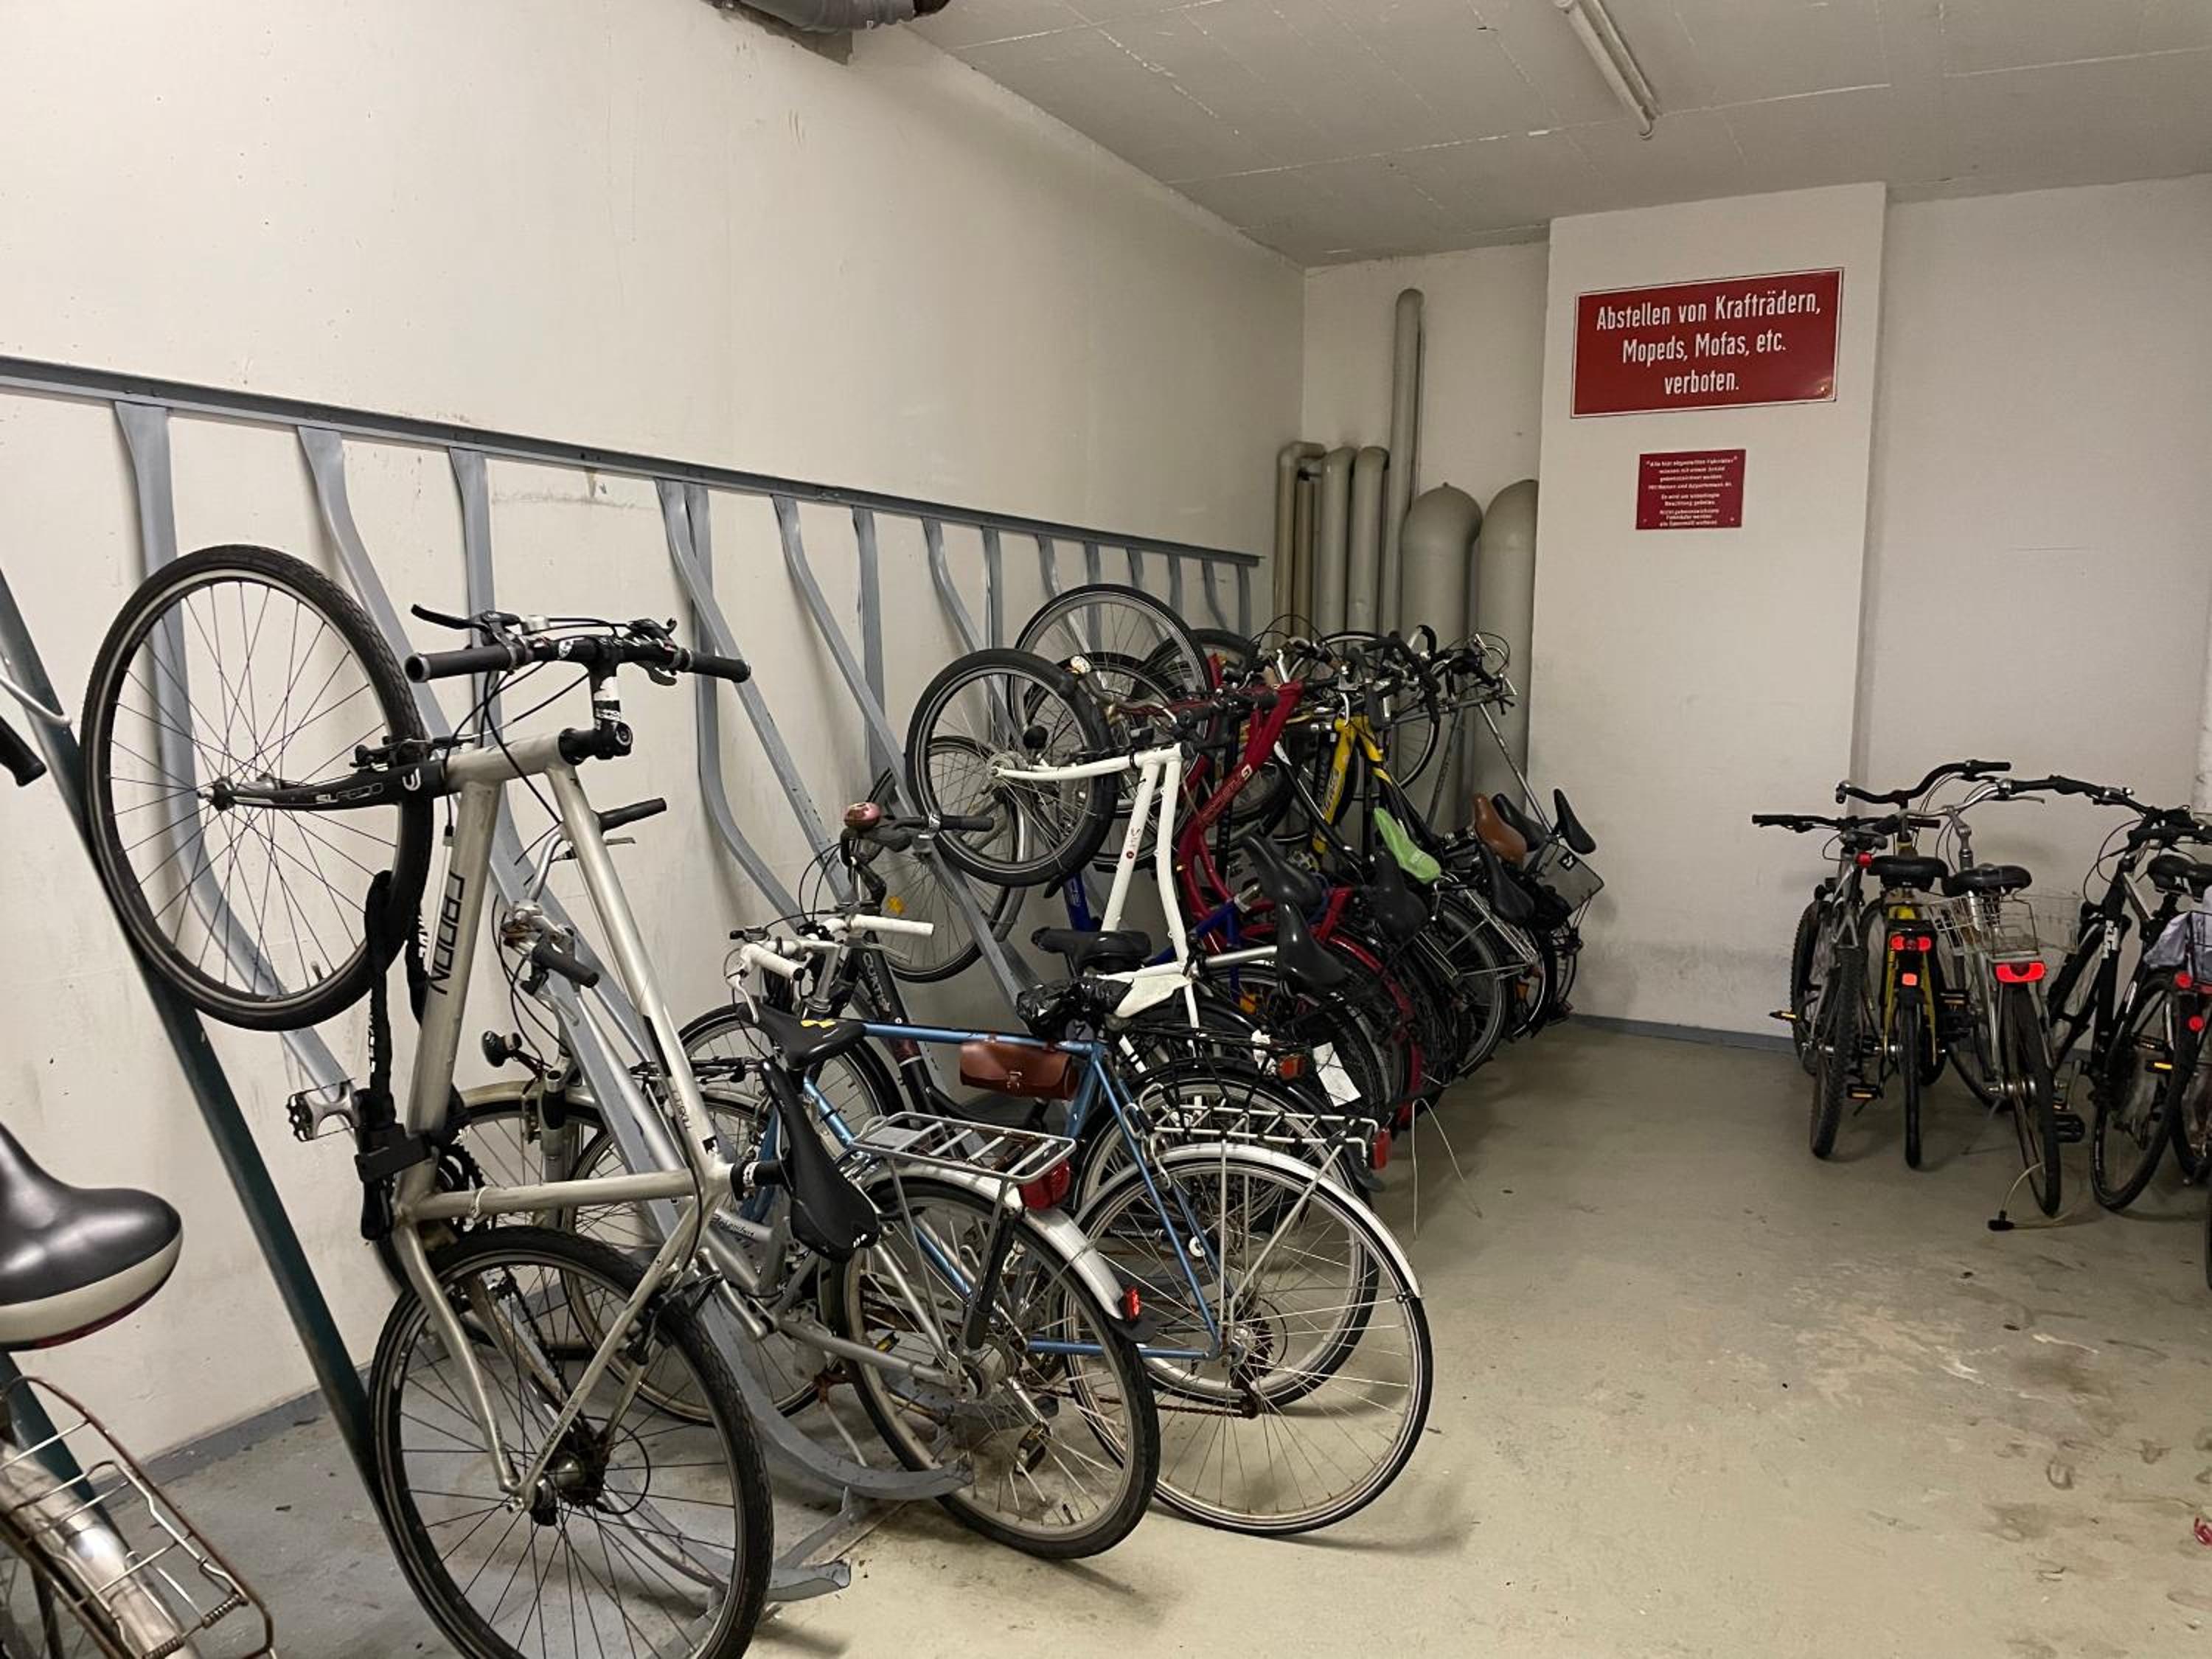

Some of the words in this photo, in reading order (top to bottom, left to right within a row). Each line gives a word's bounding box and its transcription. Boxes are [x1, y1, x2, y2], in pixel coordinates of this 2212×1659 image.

[1596, 302, 1670, 330] Abstellen
[1678, 303, 1708, 323] von
[1716, 288, 1821, 320] Krafträdern,
[1622, 335, 1688, 366] Mopeds,
[1695, 332, 1750, 358] Mofas,
[1756, 329, 1787, 353] etc.
[1664, 369, 1740, 395] verboten.
